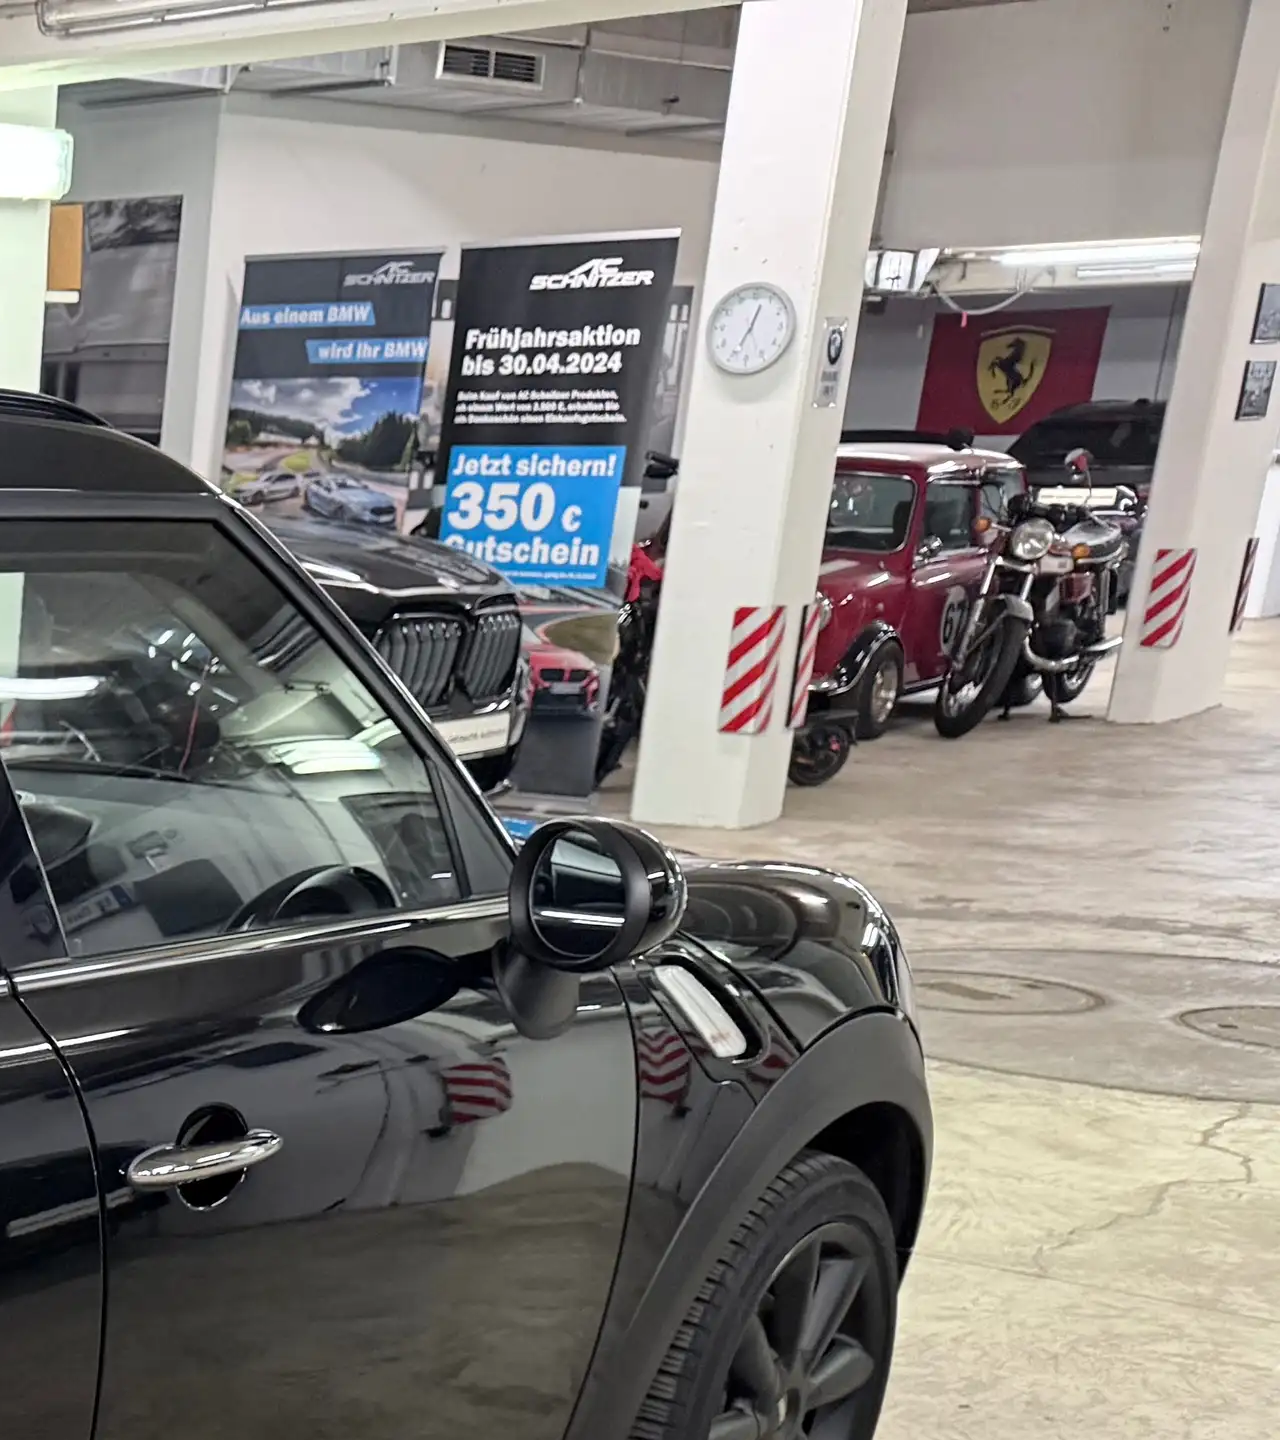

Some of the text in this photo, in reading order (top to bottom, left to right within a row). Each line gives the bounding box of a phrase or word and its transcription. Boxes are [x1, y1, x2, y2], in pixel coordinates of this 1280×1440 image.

[343, 271, 435, 287] SCHNITZER
[529, 270, 655, 290] SCHNITZER
[241, 305, 371, 325] Aus einem BMW
[465, 323, 641, 352] Frühjahrsaktion
[318, 340, 428, 360] wird Ihr BMW
[461, 350, 623, 376] bis 30.04.2024
[452, 453, 618, 477] Jetzt sichern!
[447, 481, 556, 532] 350
